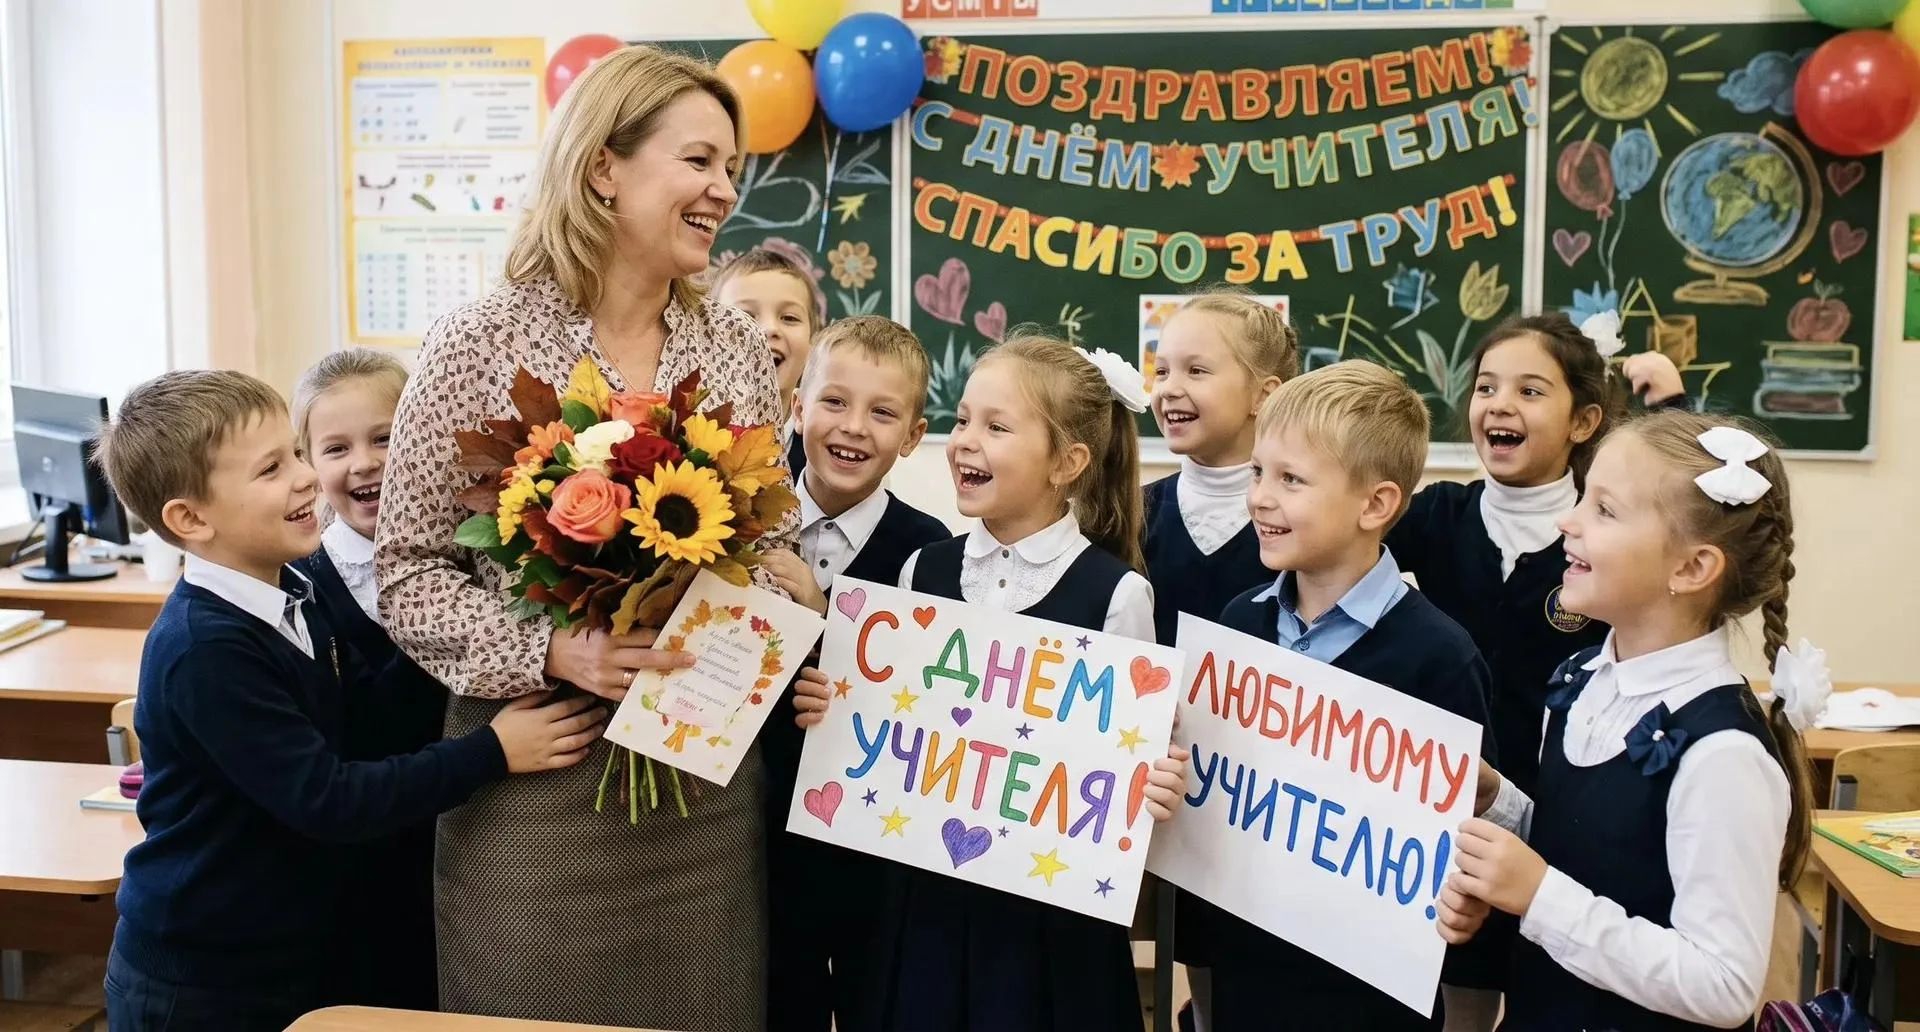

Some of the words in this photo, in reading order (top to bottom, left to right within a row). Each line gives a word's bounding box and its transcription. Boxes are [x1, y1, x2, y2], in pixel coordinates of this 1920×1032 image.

[910, 102, 954, 151] С
[962, 122, 1153, 192] ДНЁМ
[1201, 77, 1541, 195] УЧИТЕЛЯ!
[958, 33, 1496, 123] ПОЗДРАВЛЯЕМ!
[913, 182, 1207, 284] СПАСИБО
[1225, 231, 1308, 284] ЗА
[1319, 175, 1518, 274] ТРУД!
[855, 611, 900, 683] С
[922, 628, 1114, 733] ДНЁМ
[1187, 651, 1470, 814] ЛЮБИМОМУ
[846, 712, 1149, 851] УЧИТЕЛЯ!
[1184, 743, 1452, 921] УЧИТЕЛЮ!
